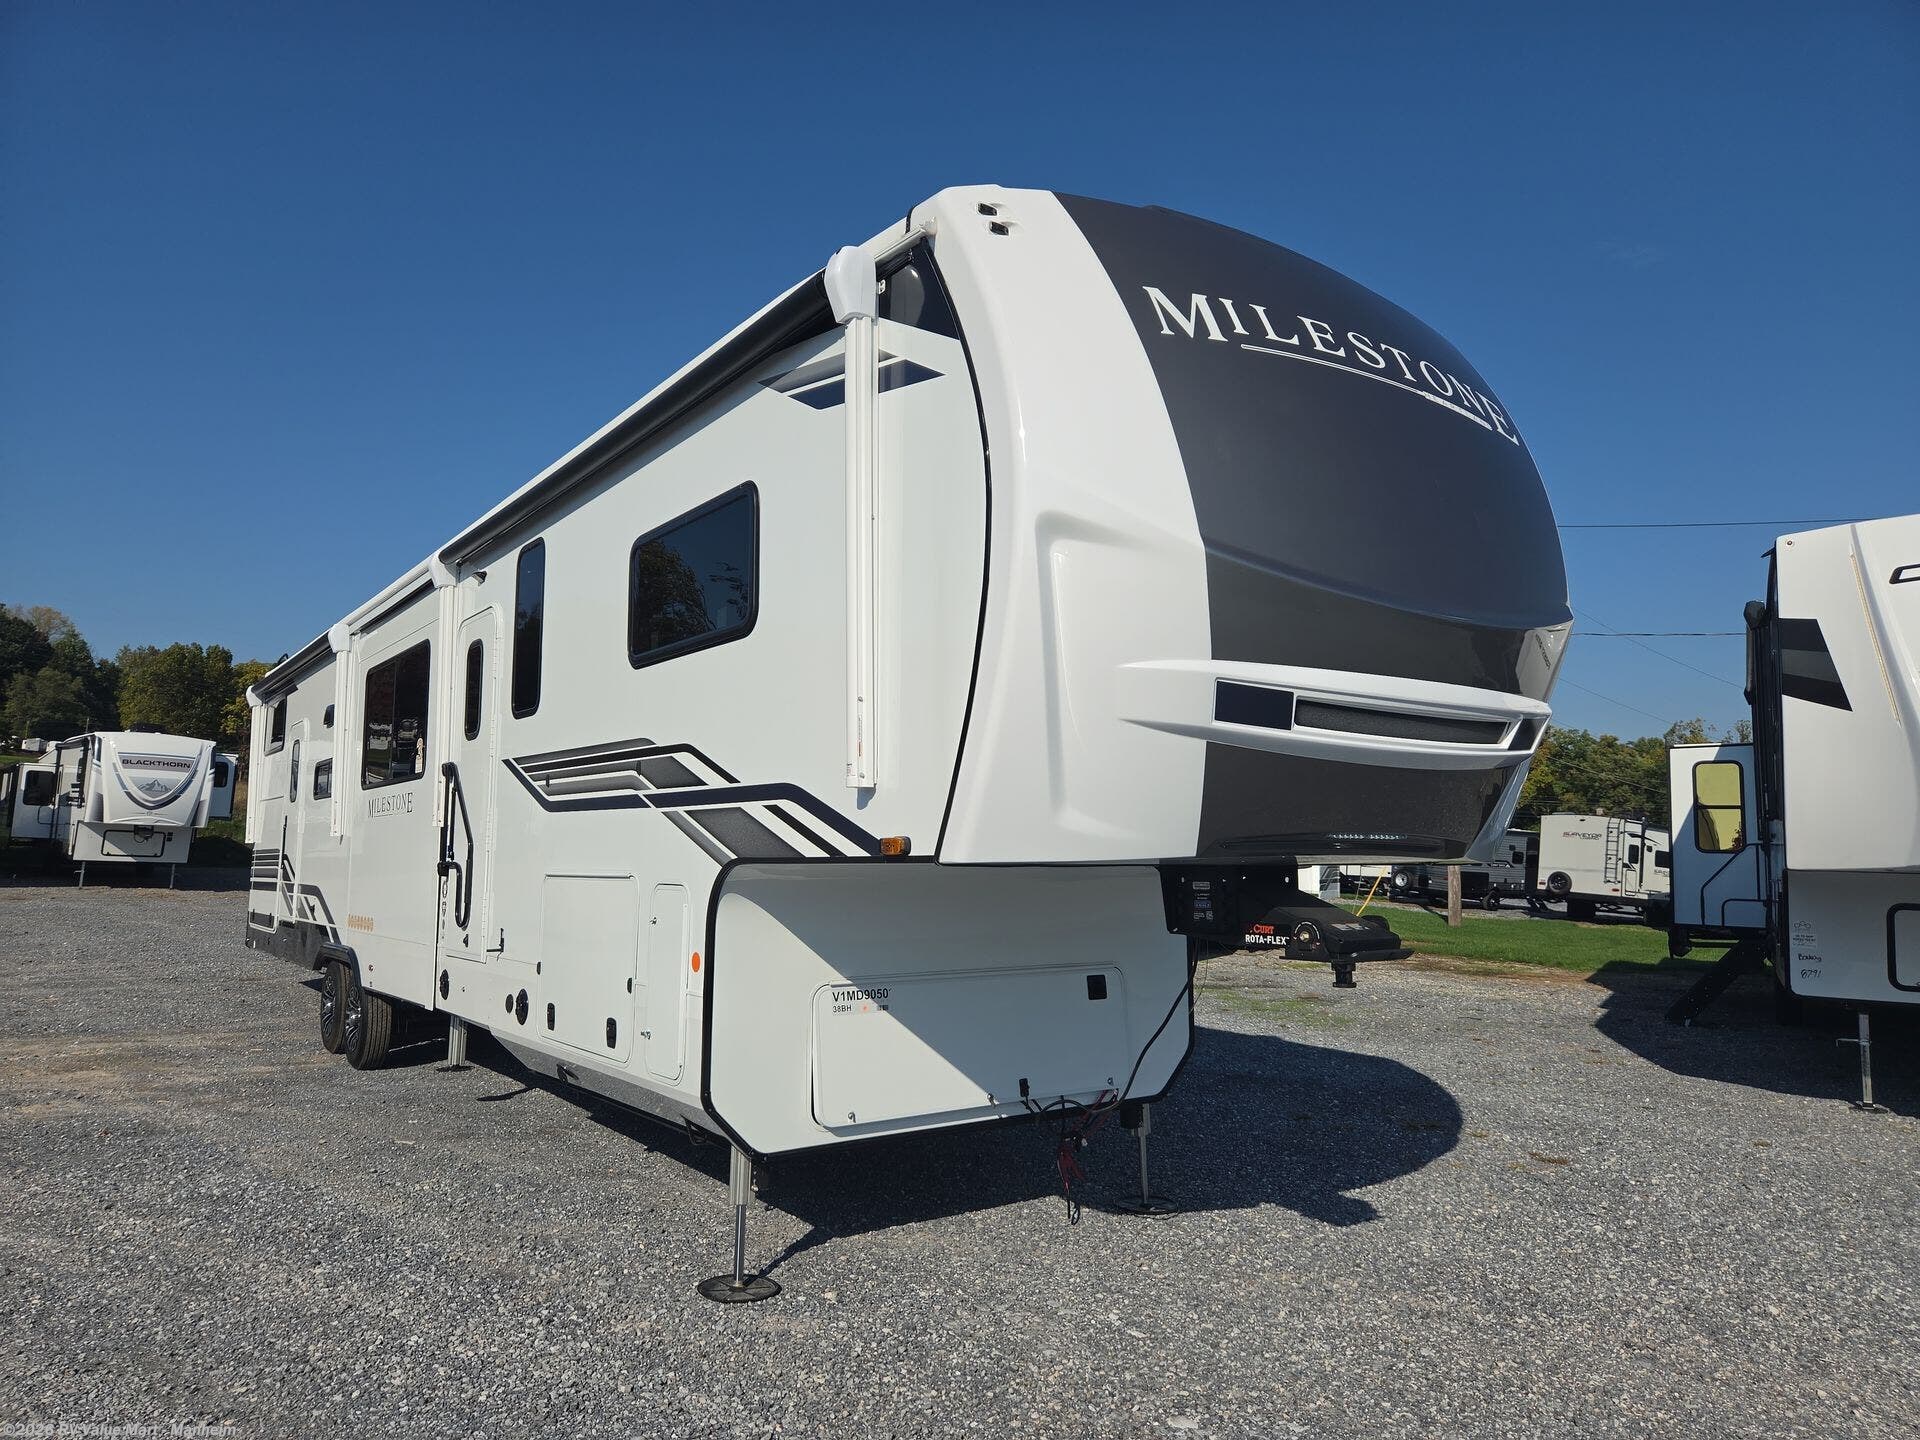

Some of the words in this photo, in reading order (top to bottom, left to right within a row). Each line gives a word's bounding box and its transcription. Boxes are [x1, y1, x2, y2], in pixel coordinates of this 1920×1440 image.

[1142, 285, 1519, 445] MILESTONE
[122, 759, 191, 768] BLACKTHORN
[368, 792, 413, 818] MILESTONE
[833, 1004, 852, 1013] 38BH
